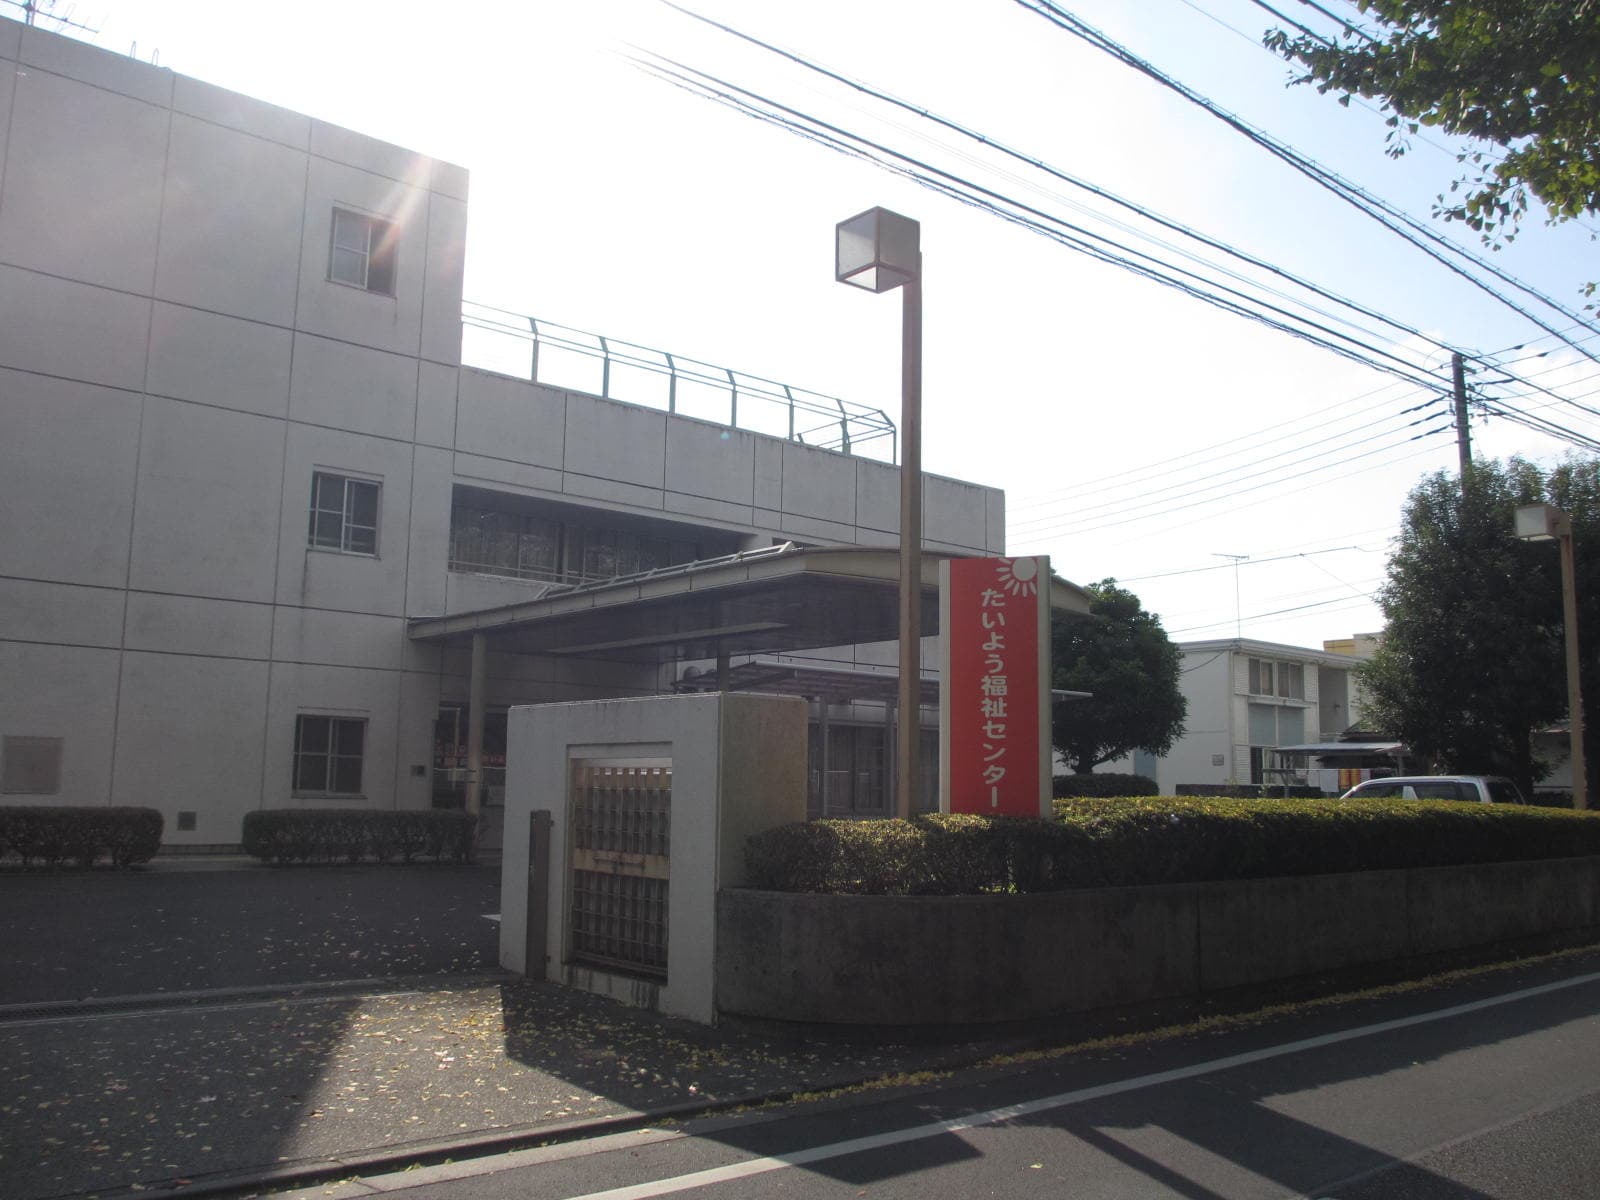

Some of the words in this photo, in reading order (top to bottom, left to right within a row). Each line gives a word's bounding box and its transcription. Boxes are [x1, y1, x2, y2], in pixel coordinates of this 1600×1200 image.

[981, 588, 1007, 807] たいよう福祉センター
